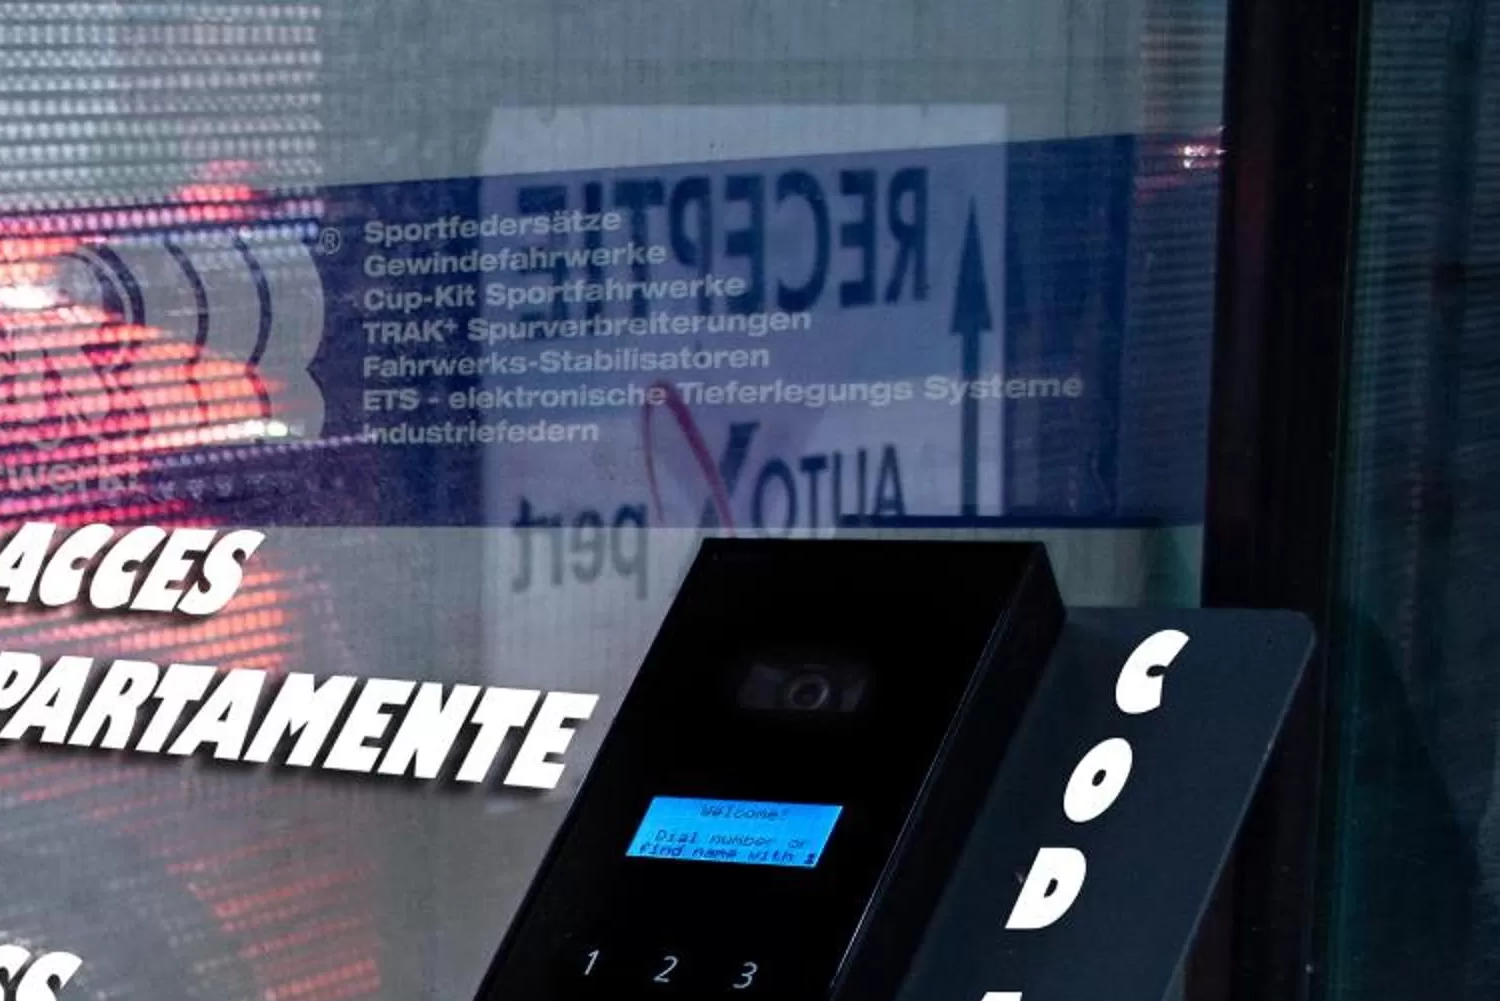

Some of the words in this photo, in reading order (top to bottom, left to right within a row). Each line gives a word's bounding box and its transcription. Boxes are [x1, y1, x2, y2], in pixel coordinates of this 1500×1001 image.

[363, 209, 622, 248] Sportfedersätze
[363, 241, 667, 278] Gewindefahrwerke
[363, 284, 476, 315] Cup-Kit
[485, 273, 746, 310] Sportfahrwerke
[466, 309, 812, 346] Spurverbreiterungen
[363, 344, 770, 378] Fahrwerks-Stabilisatoren
[363, 388, 420, 412] ETS
[450, 382, 668, 411] elektronische
[676, 376, 913, 408] Tieferlegungs
[923, 372, 1084, 404] Systeme
[364, 419, 600, 446] Industriefedern
[708, 833, 773, 846] number
[584, 949, 600, 976] 1
[653, 955, 679, 983] 2
[732, 961, 759, 989] 3
